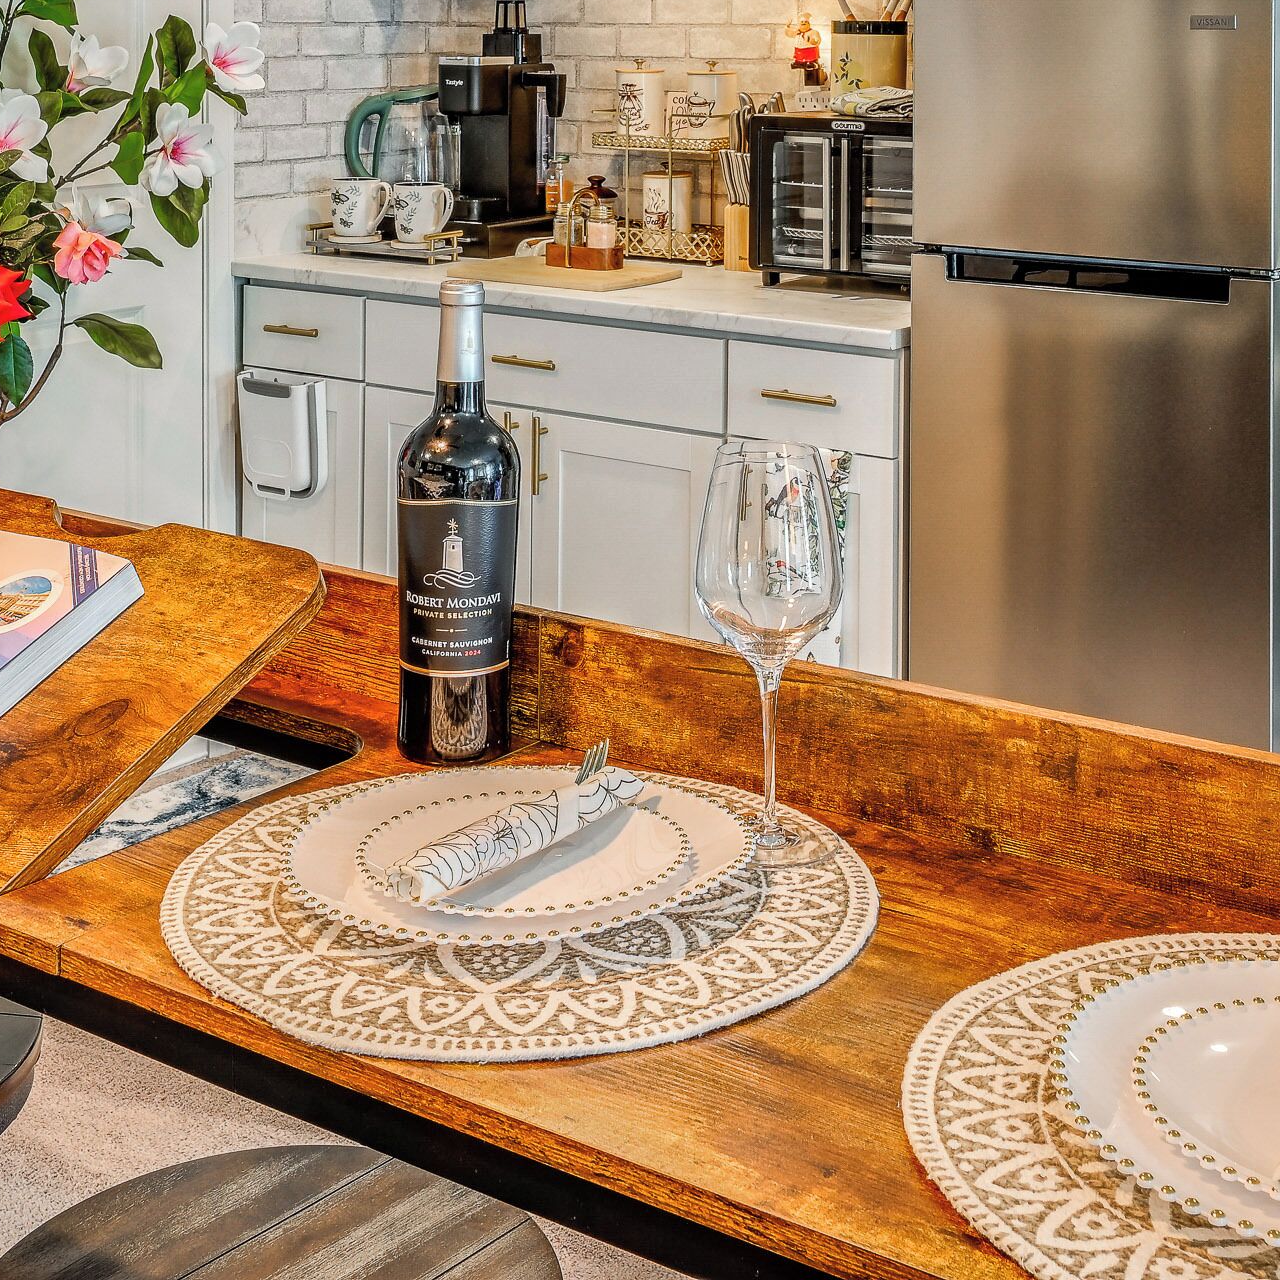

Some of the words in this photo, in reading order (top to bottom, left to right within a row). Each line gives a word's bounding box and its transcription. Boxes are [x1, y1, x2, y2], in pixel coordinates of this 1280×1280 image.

[406, 591, 444, 608] ROBERT
[447, 592, 501, 609] MONDAVI
[414, 608, 444, 619] PRIVATE
[447, 608, 493, 619] SELECTION
[412, 636, 447, 648] CABERNET
[450, 637, 493, 648] SAUVIGNON
[422, 649, 462, 657] CALIFORNIA
